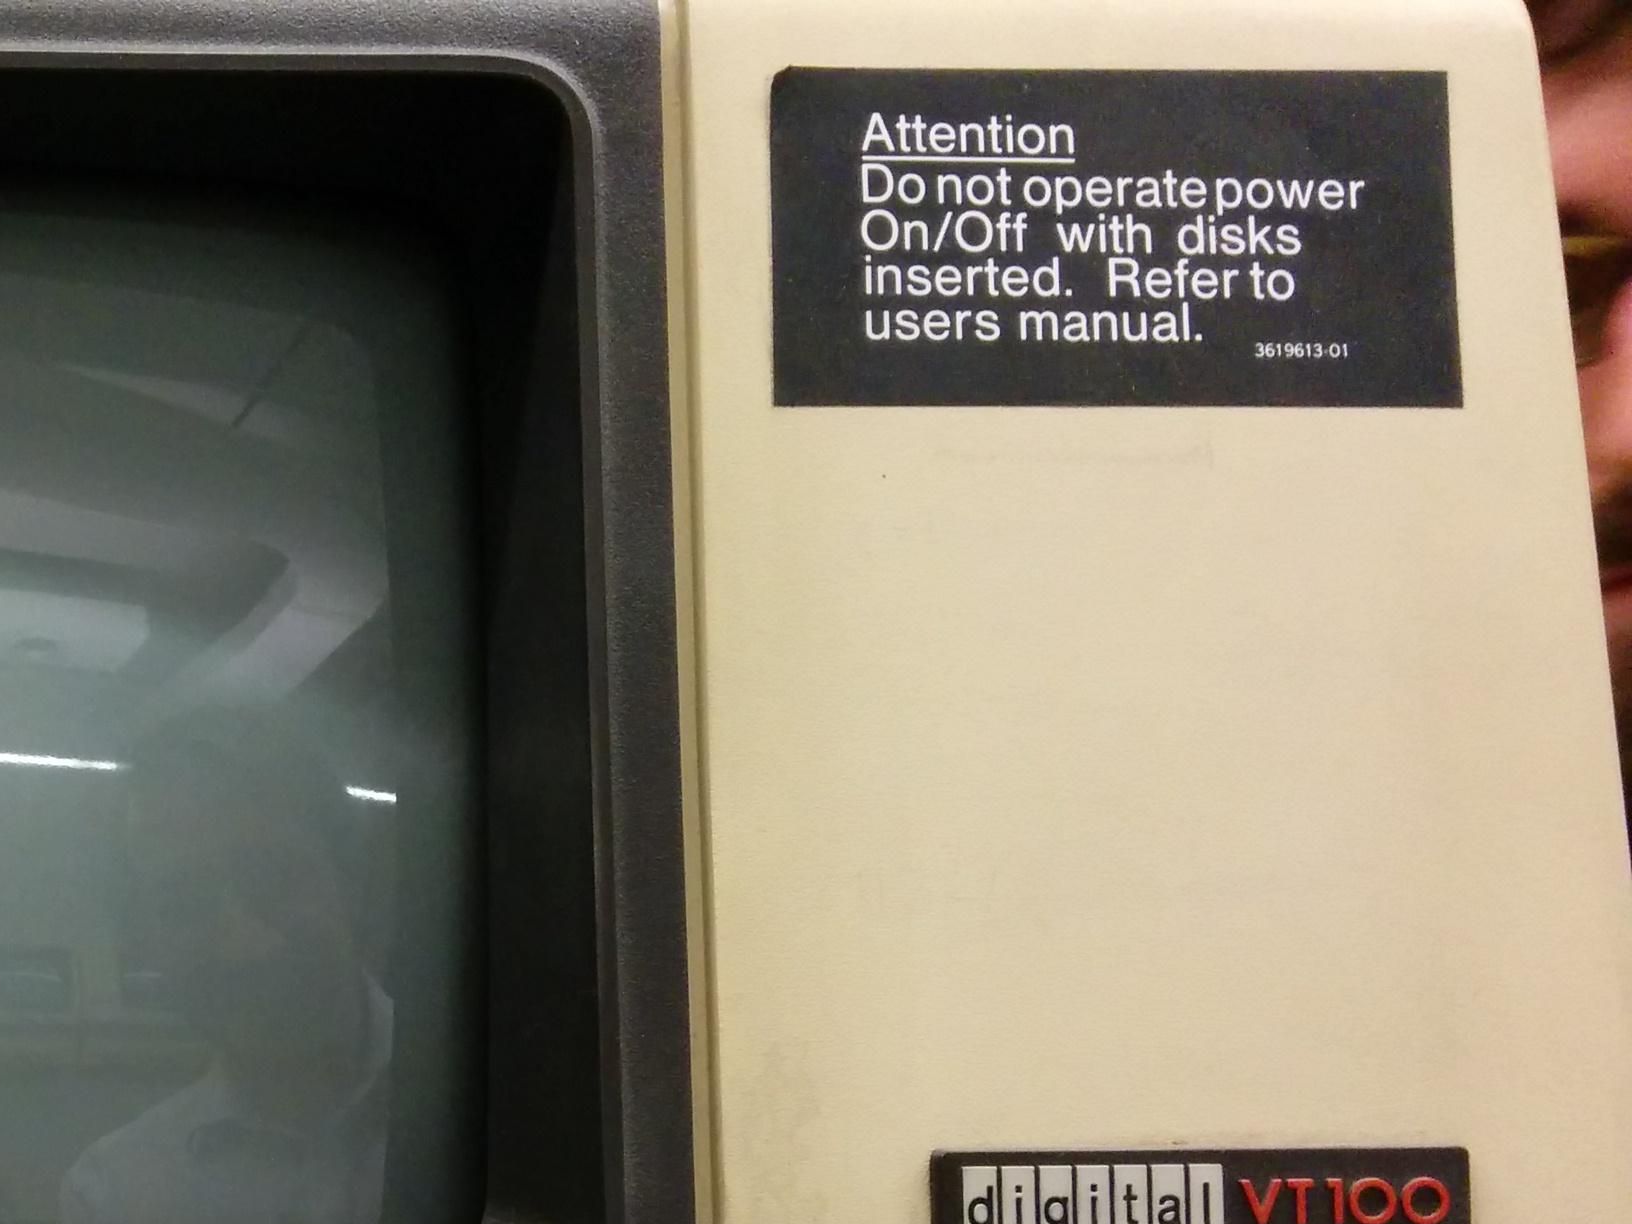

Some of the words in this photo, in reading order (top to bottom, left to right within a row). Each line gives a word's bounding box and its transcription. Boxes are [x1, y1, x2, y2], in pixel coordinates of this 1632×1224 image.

[861, 112, 1075, 155] Attention
[861, 164, 926, 204] Do
[936, 167, 1011, 205] not
[1023, 171, 1208, 214] operate
[1215, 176, 1366, 214] power
[861, 210, 1027, 252] On/Off
[1057, 214, 1153, 254] with
[1177, 216, 1301, 256] disks
[865, 255, 1073, 296] inserted.
[1108, 258, 1240, 298] Refer
[1249, 264, 1296, 299] to
[865, 307, 1001, 341] users
[1019, 304, 1203, 342] manual.
[1254, 341, 1349, 358] 3619613-01
